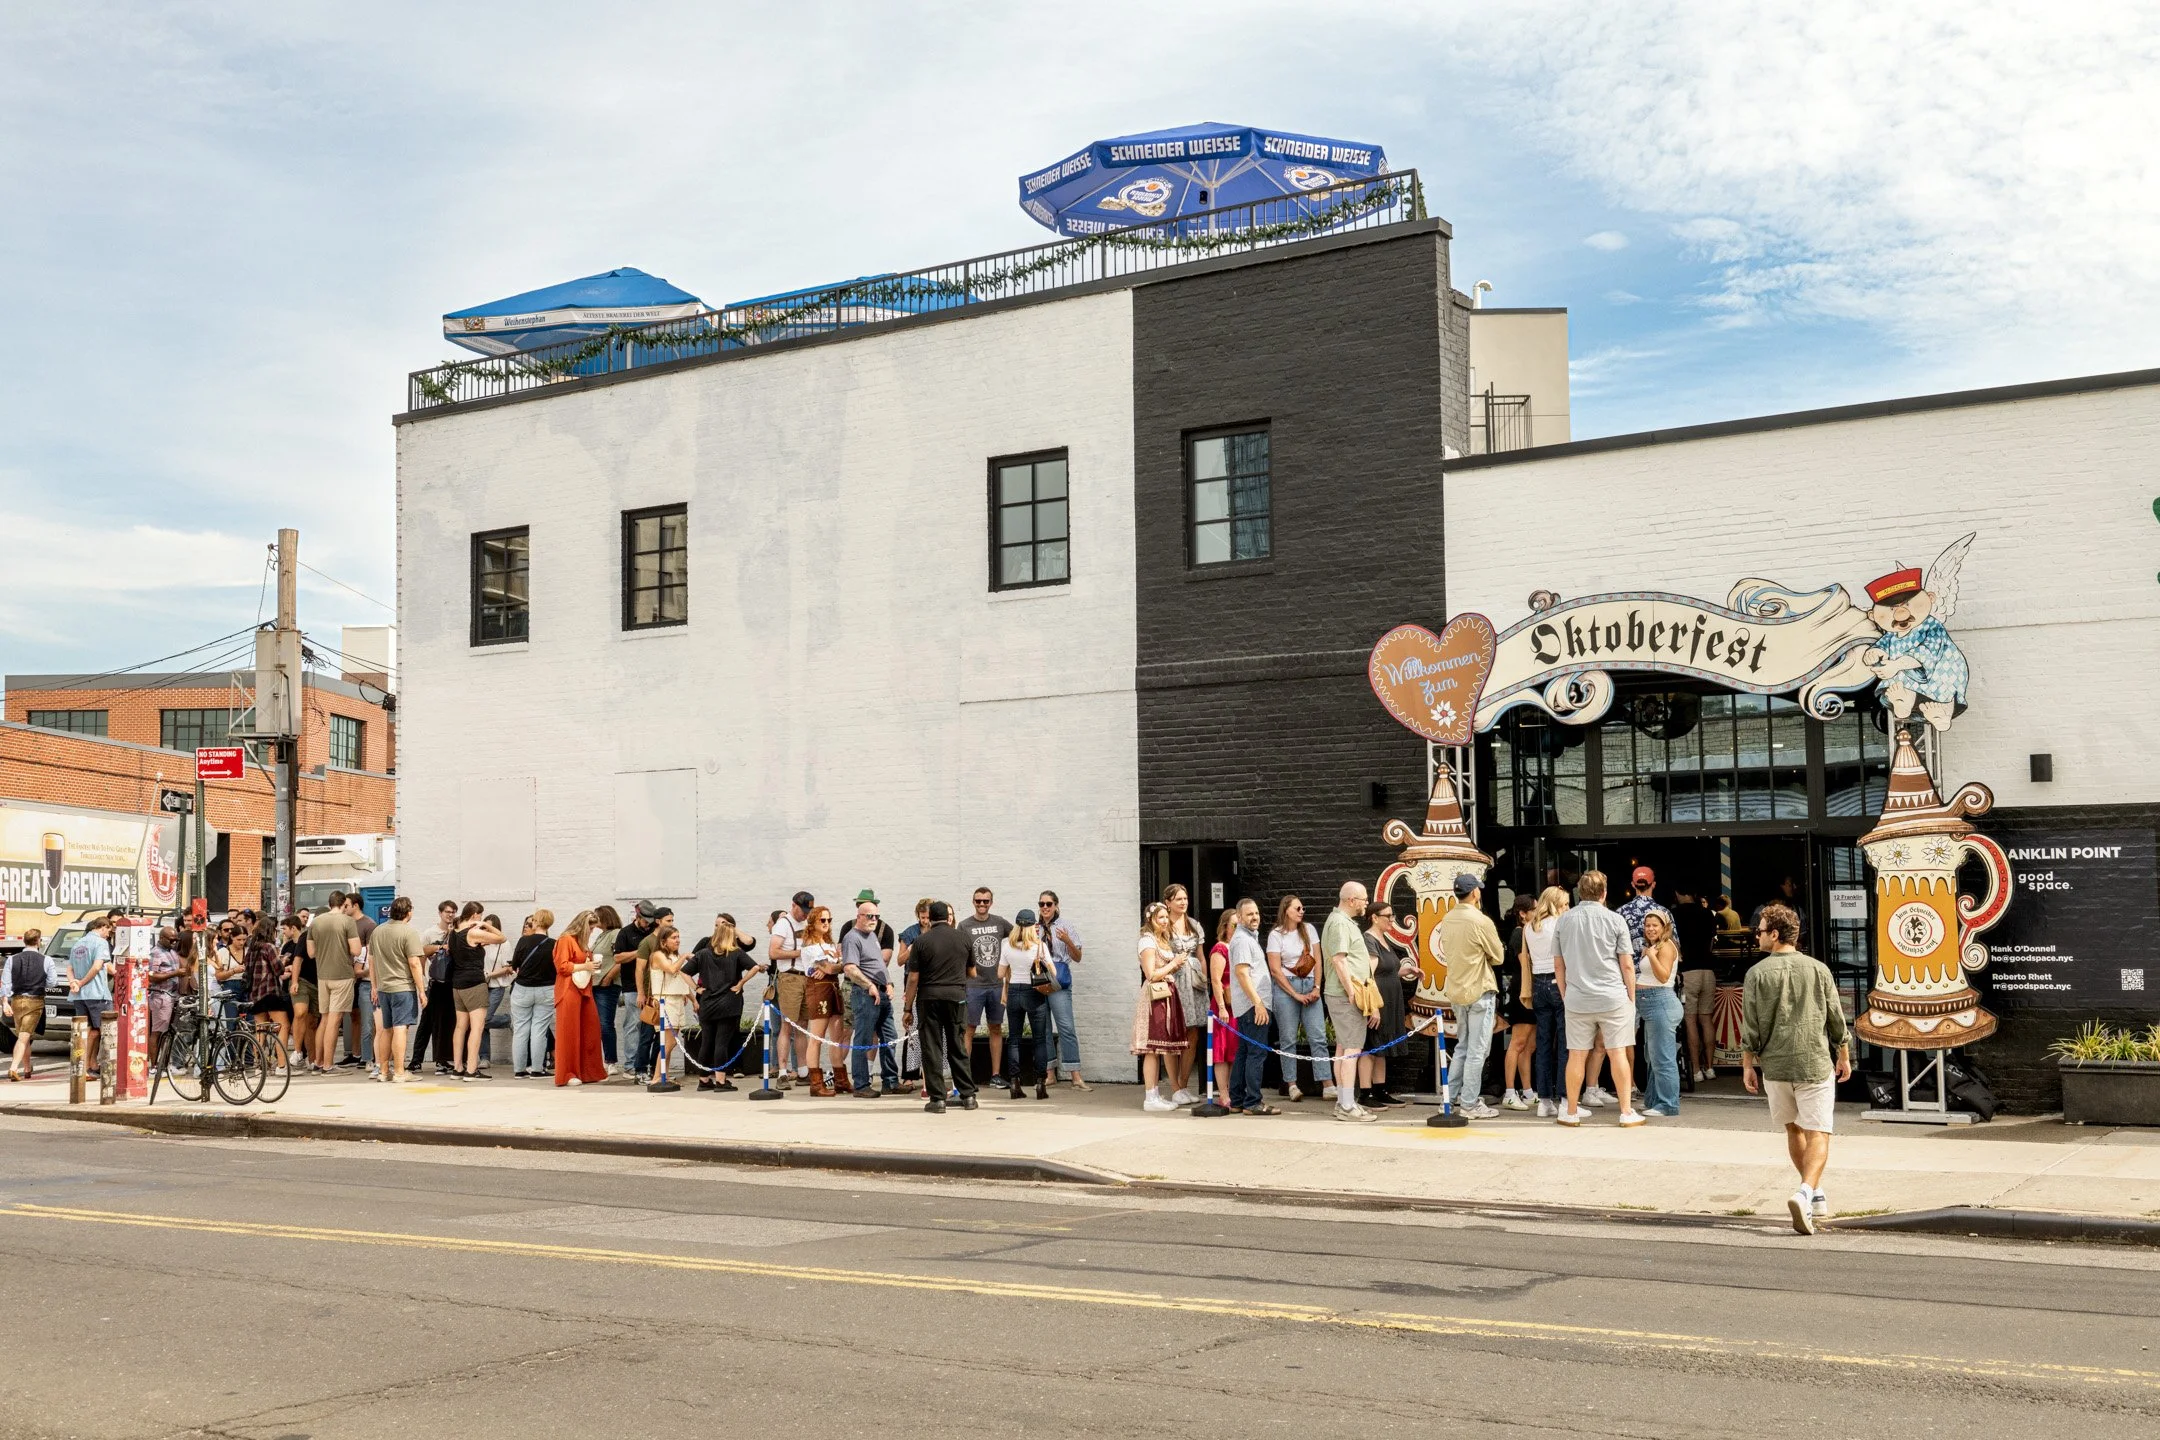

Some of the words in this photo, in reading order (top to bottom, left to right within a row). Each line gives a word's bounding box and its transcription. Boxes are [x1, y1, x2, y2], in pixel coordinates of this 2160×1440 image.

[1111, 141, 1185, 161] SCHNEIDER
[1189, 135, 1241, 155] WEISSE
[1264, 136, 1329, 160] SCHNEIDER
[1332, 146, 1372, 165] WEISSE
[1024, 165, 1061, 195] SCHNEIDER
[1061, 152, 1092, 178] WEISSE
[504, 315, 546, 326] Weihenstephan
[1530, 609, 1767, 673] Oktoberfest
[1382, 652, 1481, 687] Willkommen
[199, 758, 224, 766] Anytime
[166, 796, 177, 806] ONE
[2008, 847, 2067, 860] ANKLIN
[2071, 846, 2122, 859] POINT
[2018, 871, 2054, 883] good
[0, 866, 51, 903] GREAT
[60, 870, 130, 906] BREWERS
[2028, 881, 2074, 892] space.
[971, 926, 998, 935] STUBE
[1991, 945, 2013, 953] Hank
[2014, 944, 2056, 953] O'Donnell
[1991, 954, 2074, 963] ho@goodspace.nyc
[1992, 973, 2027, 981] Roberto
[2028, 973, 2052, 981] Rhett
[1992, 982, 2072, 991] rr@goodspace.nyc
